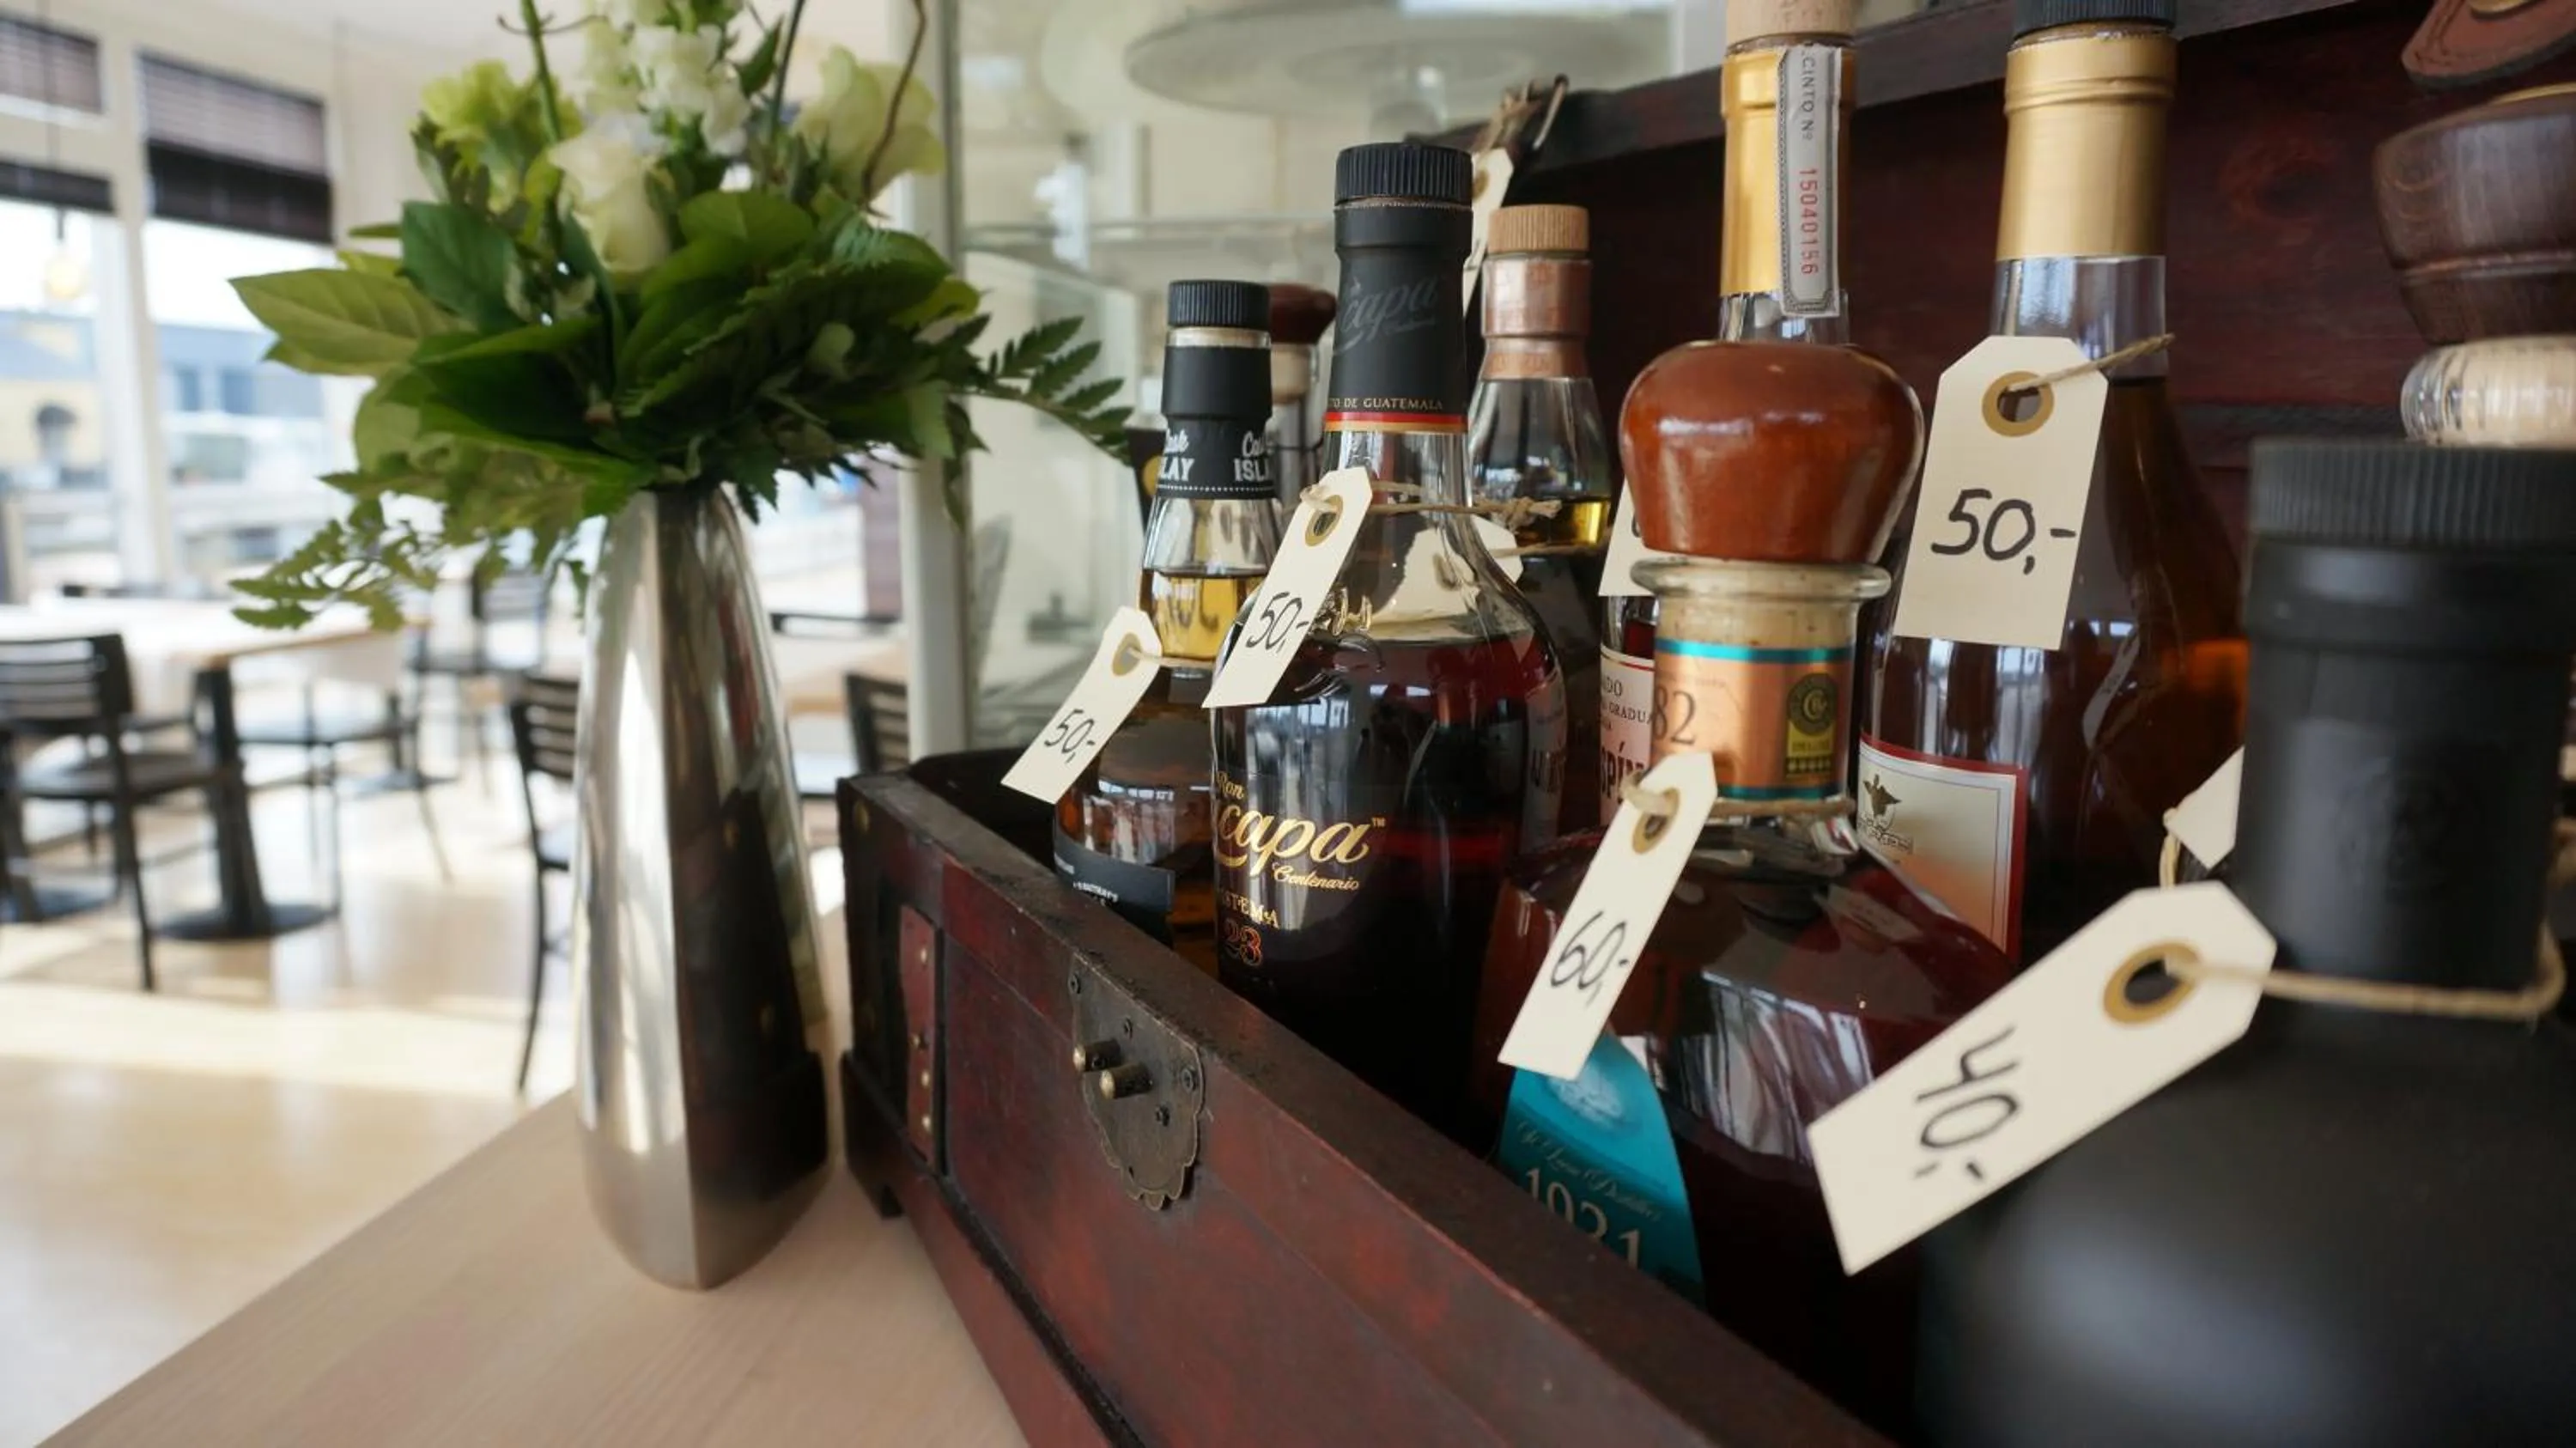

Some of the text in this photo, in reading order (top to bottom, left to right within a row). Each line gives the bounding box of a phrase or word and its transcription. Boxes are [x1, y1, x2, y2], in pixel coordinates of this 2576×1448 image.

[1801, 50, 1815, 113] CINTO
[1799, 168, 1820, 274] 15040156
[1344, 398, 1358, 408] DE
[1363, 398, 1443, 411] GUATEMALA
[1930, 487, 2077, 575] 50,-
[1245, 591, 1310, 654] 50,-
[1043, 708, 1097, 764] 50,-
[1272, 862, 1360, 891] Centenario
[1550, 910, 1629, 1007] 60,-
[1914, 1025, 2021, 1180] 40,-
